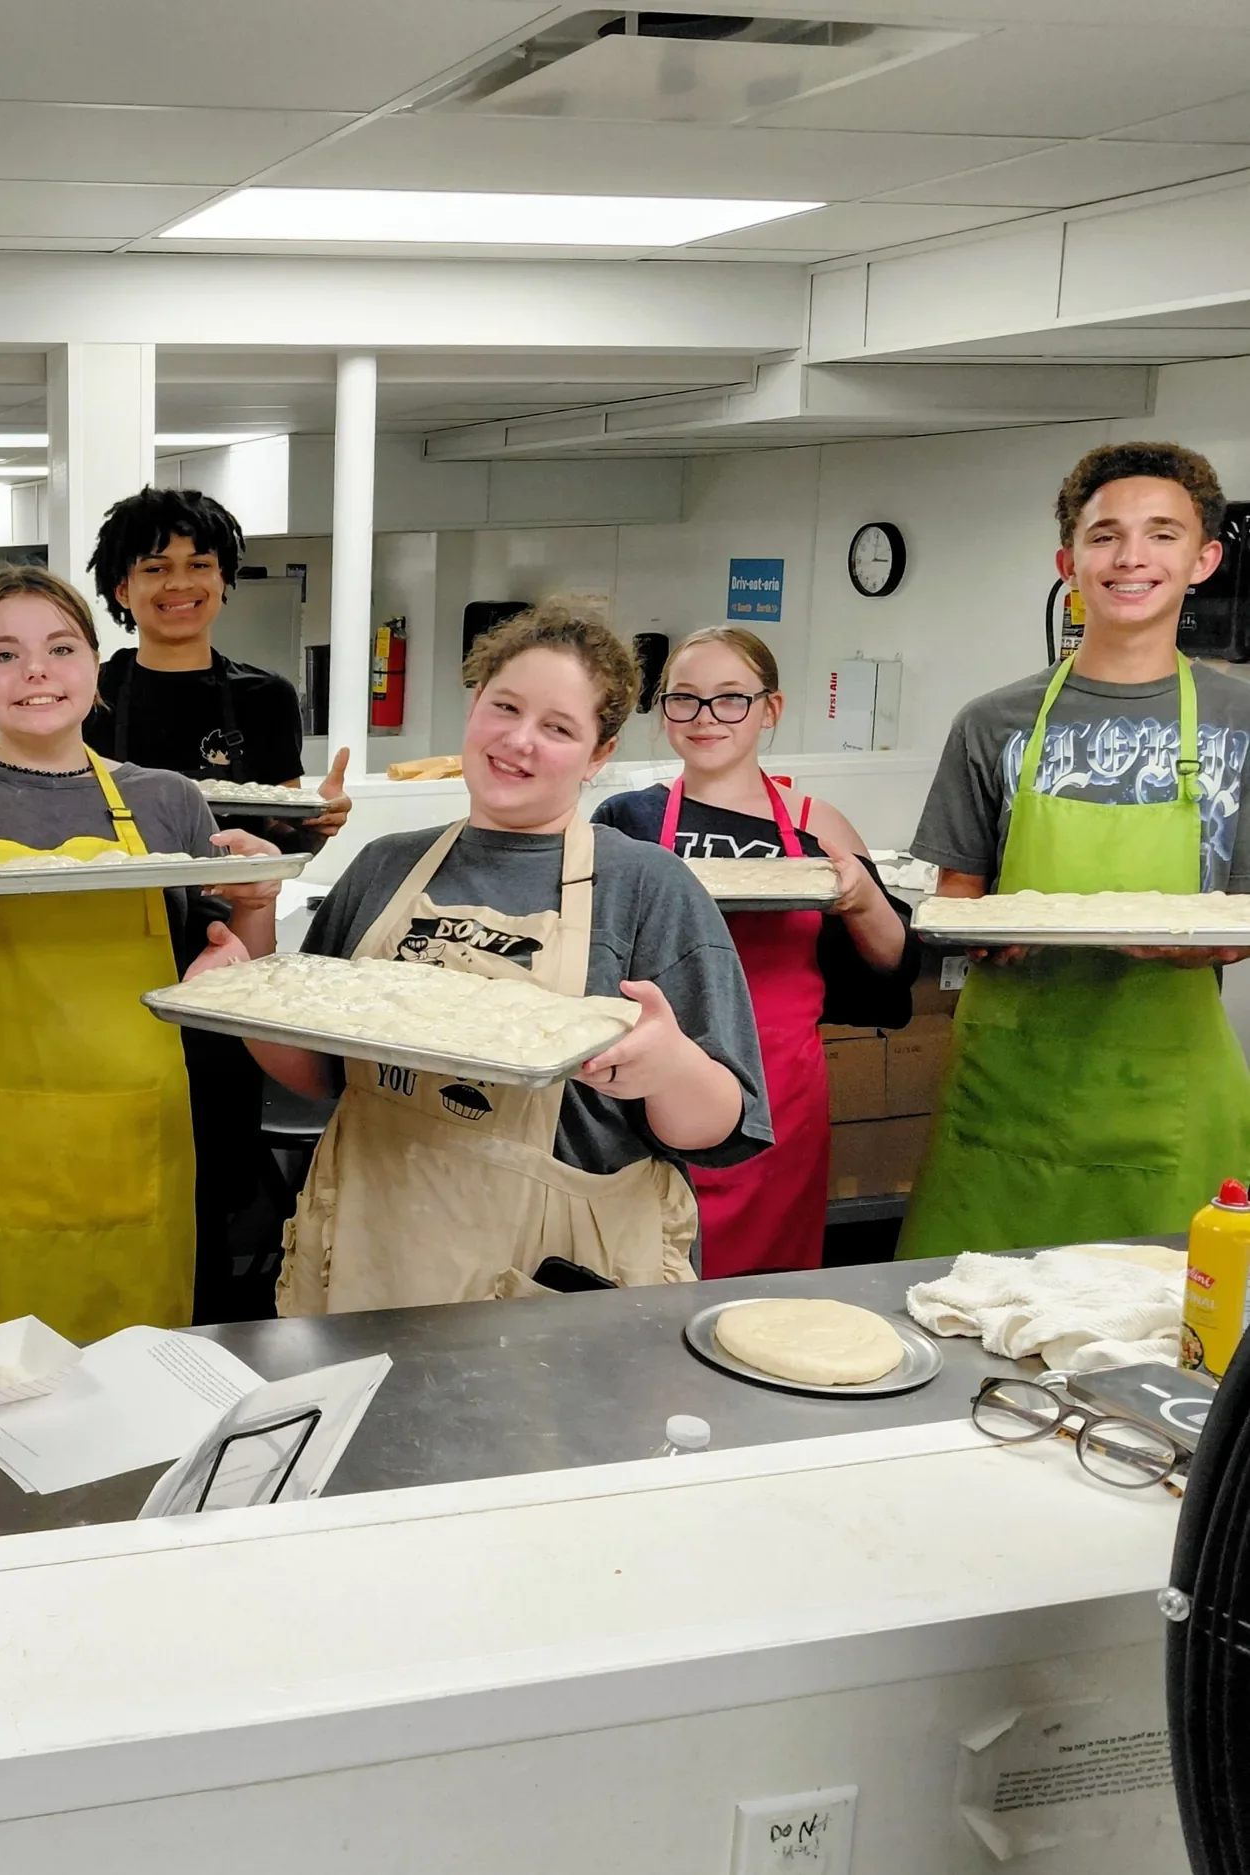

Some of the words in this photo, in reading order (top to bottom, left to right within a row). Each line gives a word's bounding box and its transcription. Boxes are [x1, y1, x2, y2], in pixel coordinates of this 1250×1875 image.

[828, 693, 837, 719] First
[435, 919, 521, 953] DON'T
[378, 1063, 418, 1097] YOU
[770, 1824, 792, 1843] DO
